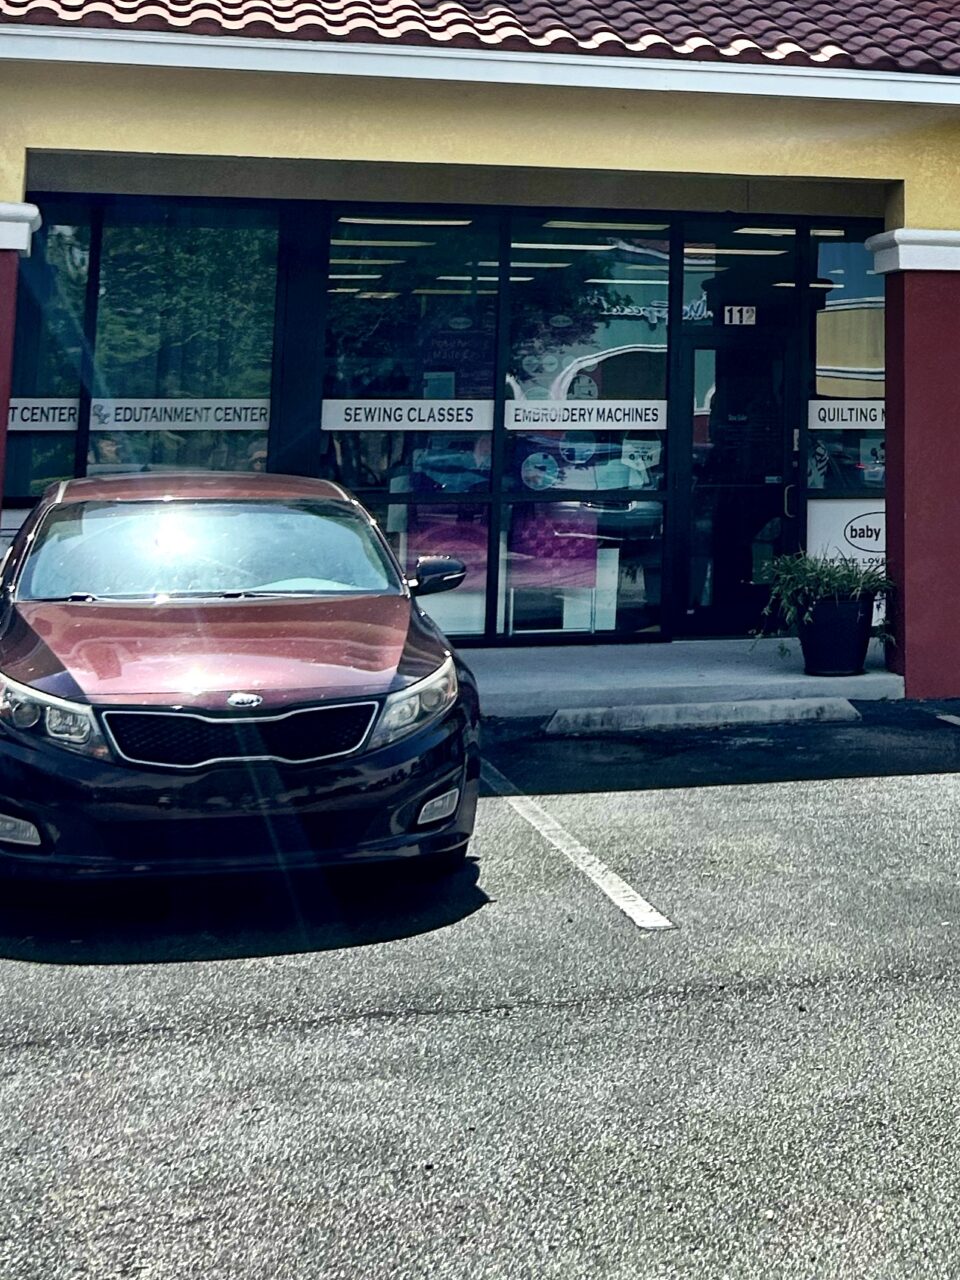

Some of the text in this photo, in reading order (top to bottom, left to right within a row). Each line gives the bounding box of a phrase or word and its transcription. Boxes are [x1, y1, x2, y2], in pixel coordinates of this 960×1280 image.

[20, 405, 77, 423] CENTER
[114, 406, 211, 422] EDUTAINMENT
[214, 406, 268, 423] CENTER
[343, 407, 474, 423] SEWING CLASSES
[513, 407, 659, 422] EMBROIDERY MACHINES
[818, 407, 878, 423] QUILTING
[629, 453, 653, 461] OEN
[850, 525, 881, 541] baby
